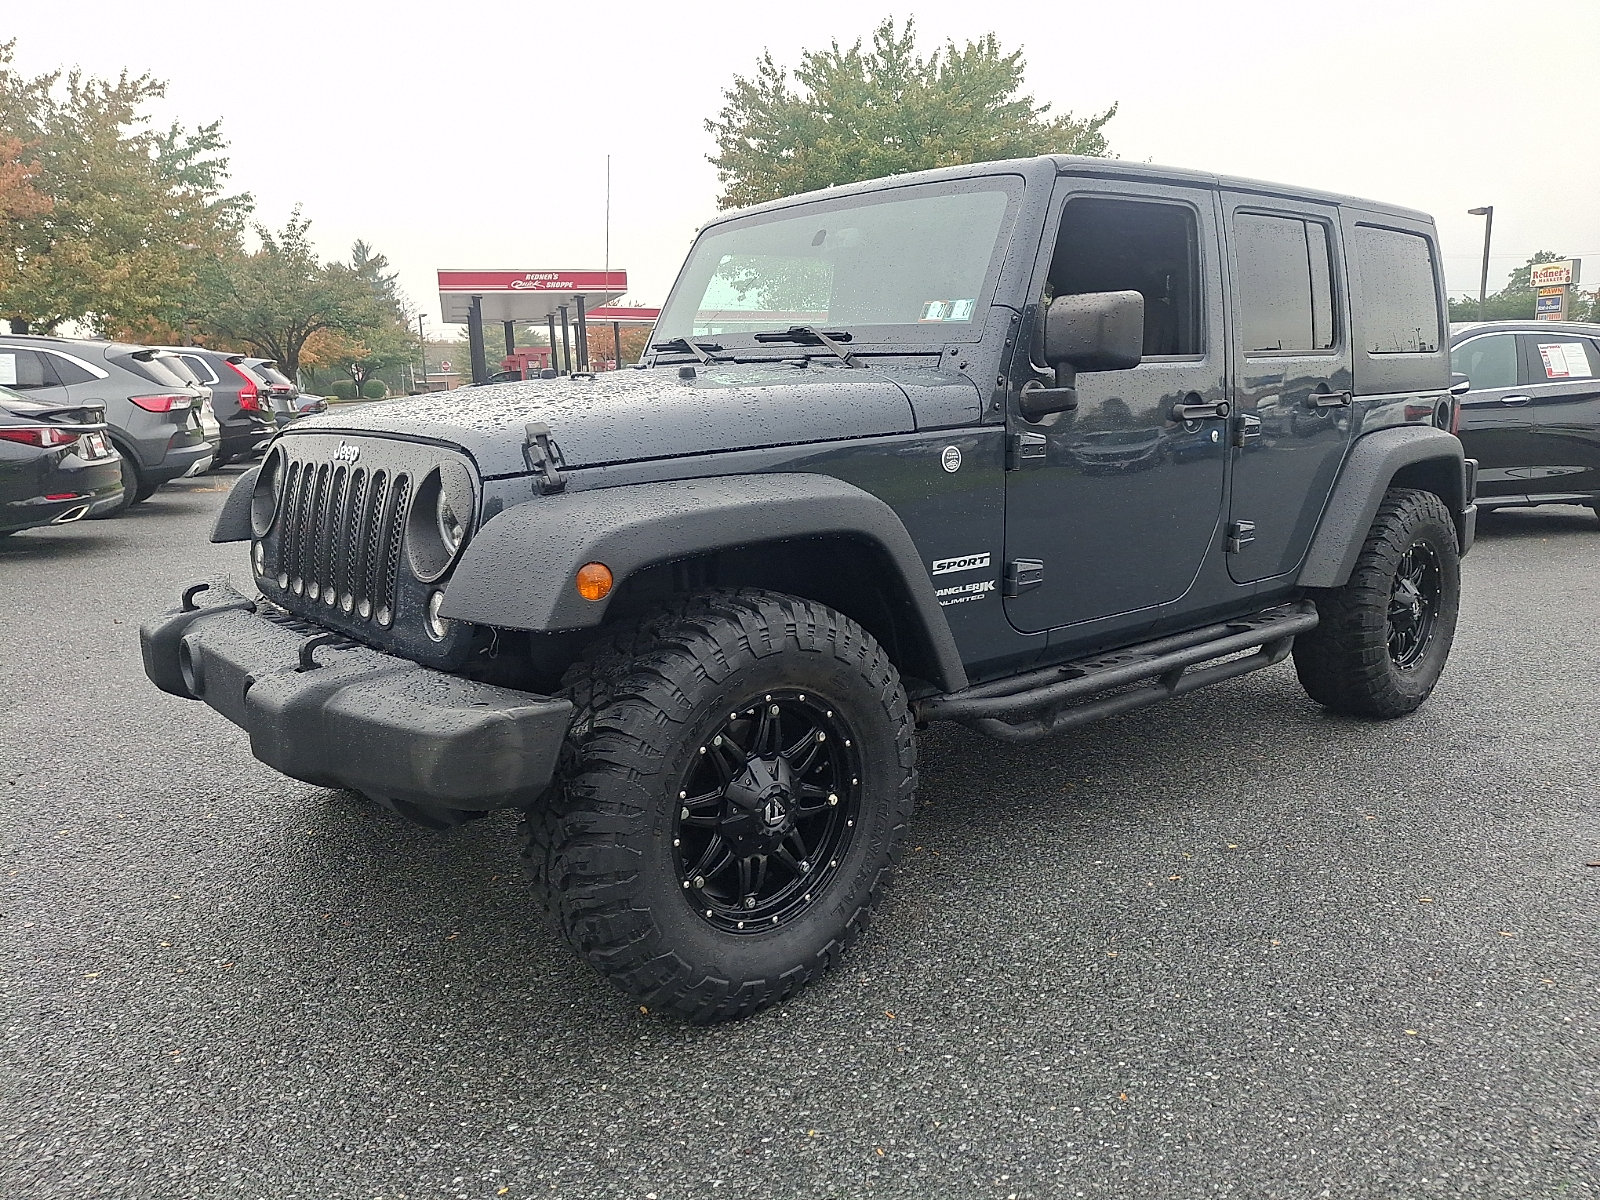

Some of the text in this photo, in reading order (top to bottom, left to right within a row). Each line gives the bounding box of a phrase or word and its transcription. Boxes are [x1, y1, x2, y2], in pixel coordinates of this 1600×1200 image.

[525, 272, 559, 281] REDNER'S
[1532, 268, 1570, 279] Redner's
[510, 280, 545, 290] Quick
[1542, 287, 1563, 295] PAWN
[333, 440, 361, 464] Jeep
[935, 556, 989, 571] SPORT
